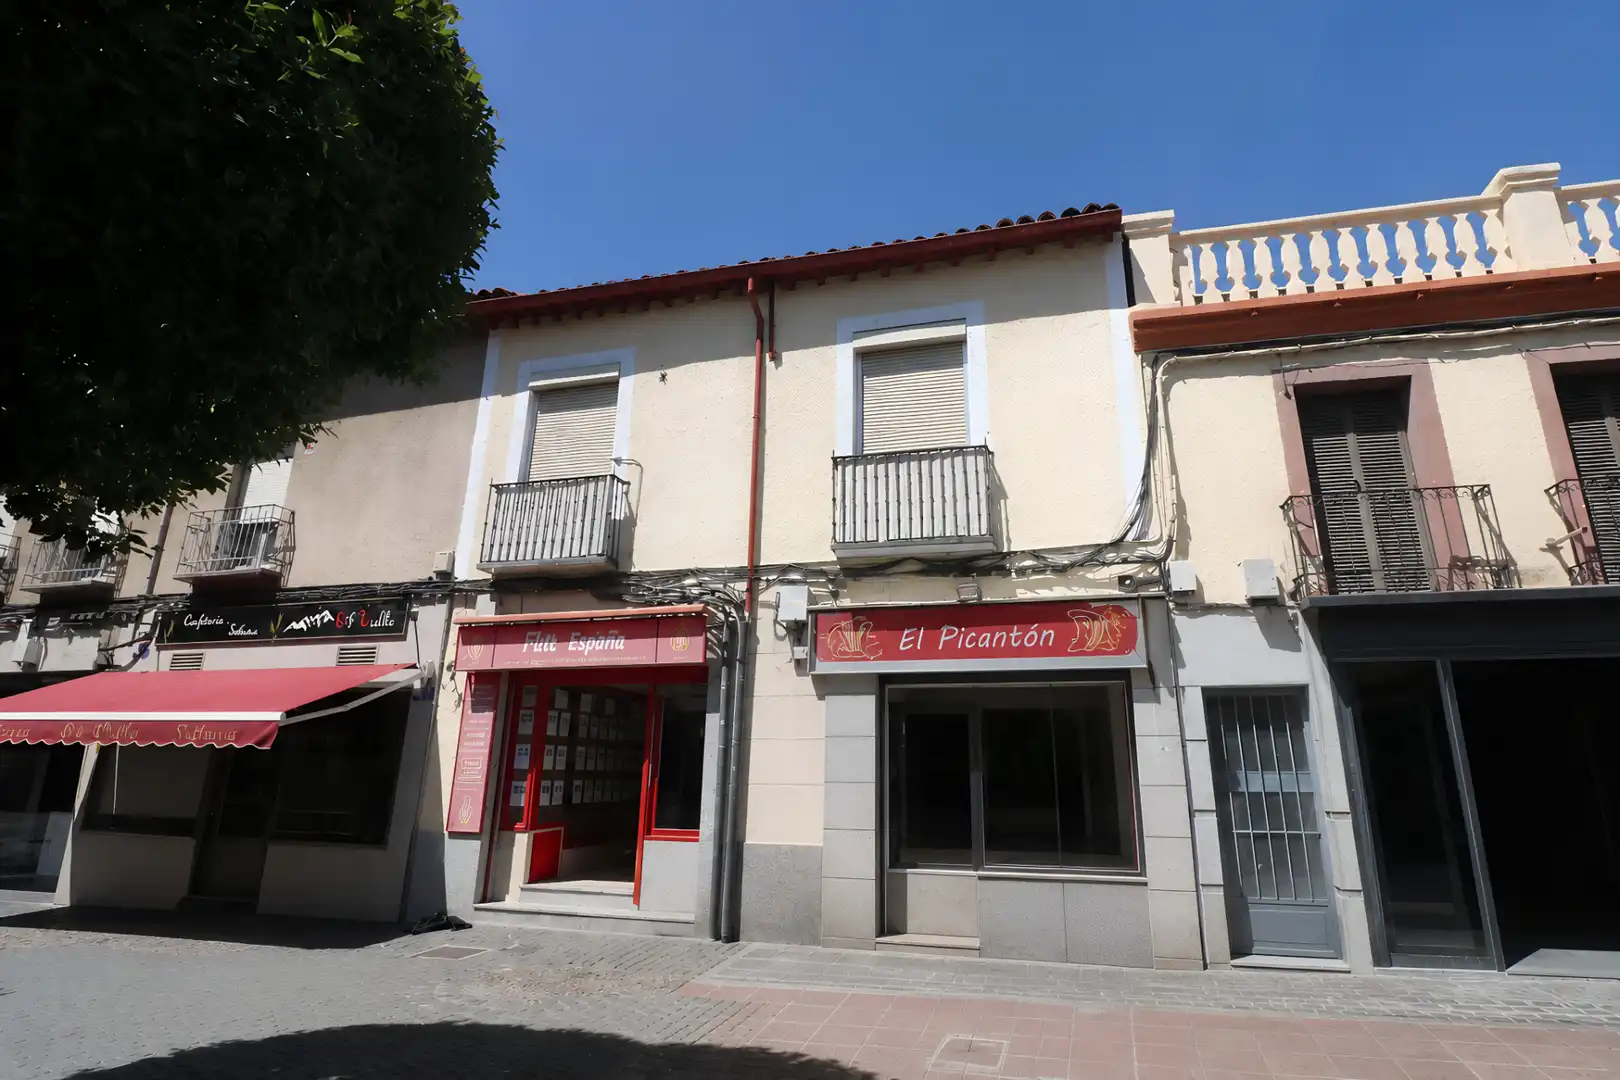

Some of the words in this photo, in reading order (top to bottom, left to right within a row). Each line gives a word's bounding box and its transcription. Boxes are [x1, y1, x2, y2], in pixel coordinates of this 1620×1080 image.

[568, 629, 626, 656] España
[898, 627, 922, 651] El
[938, 623, 1056, 651] Picantón
